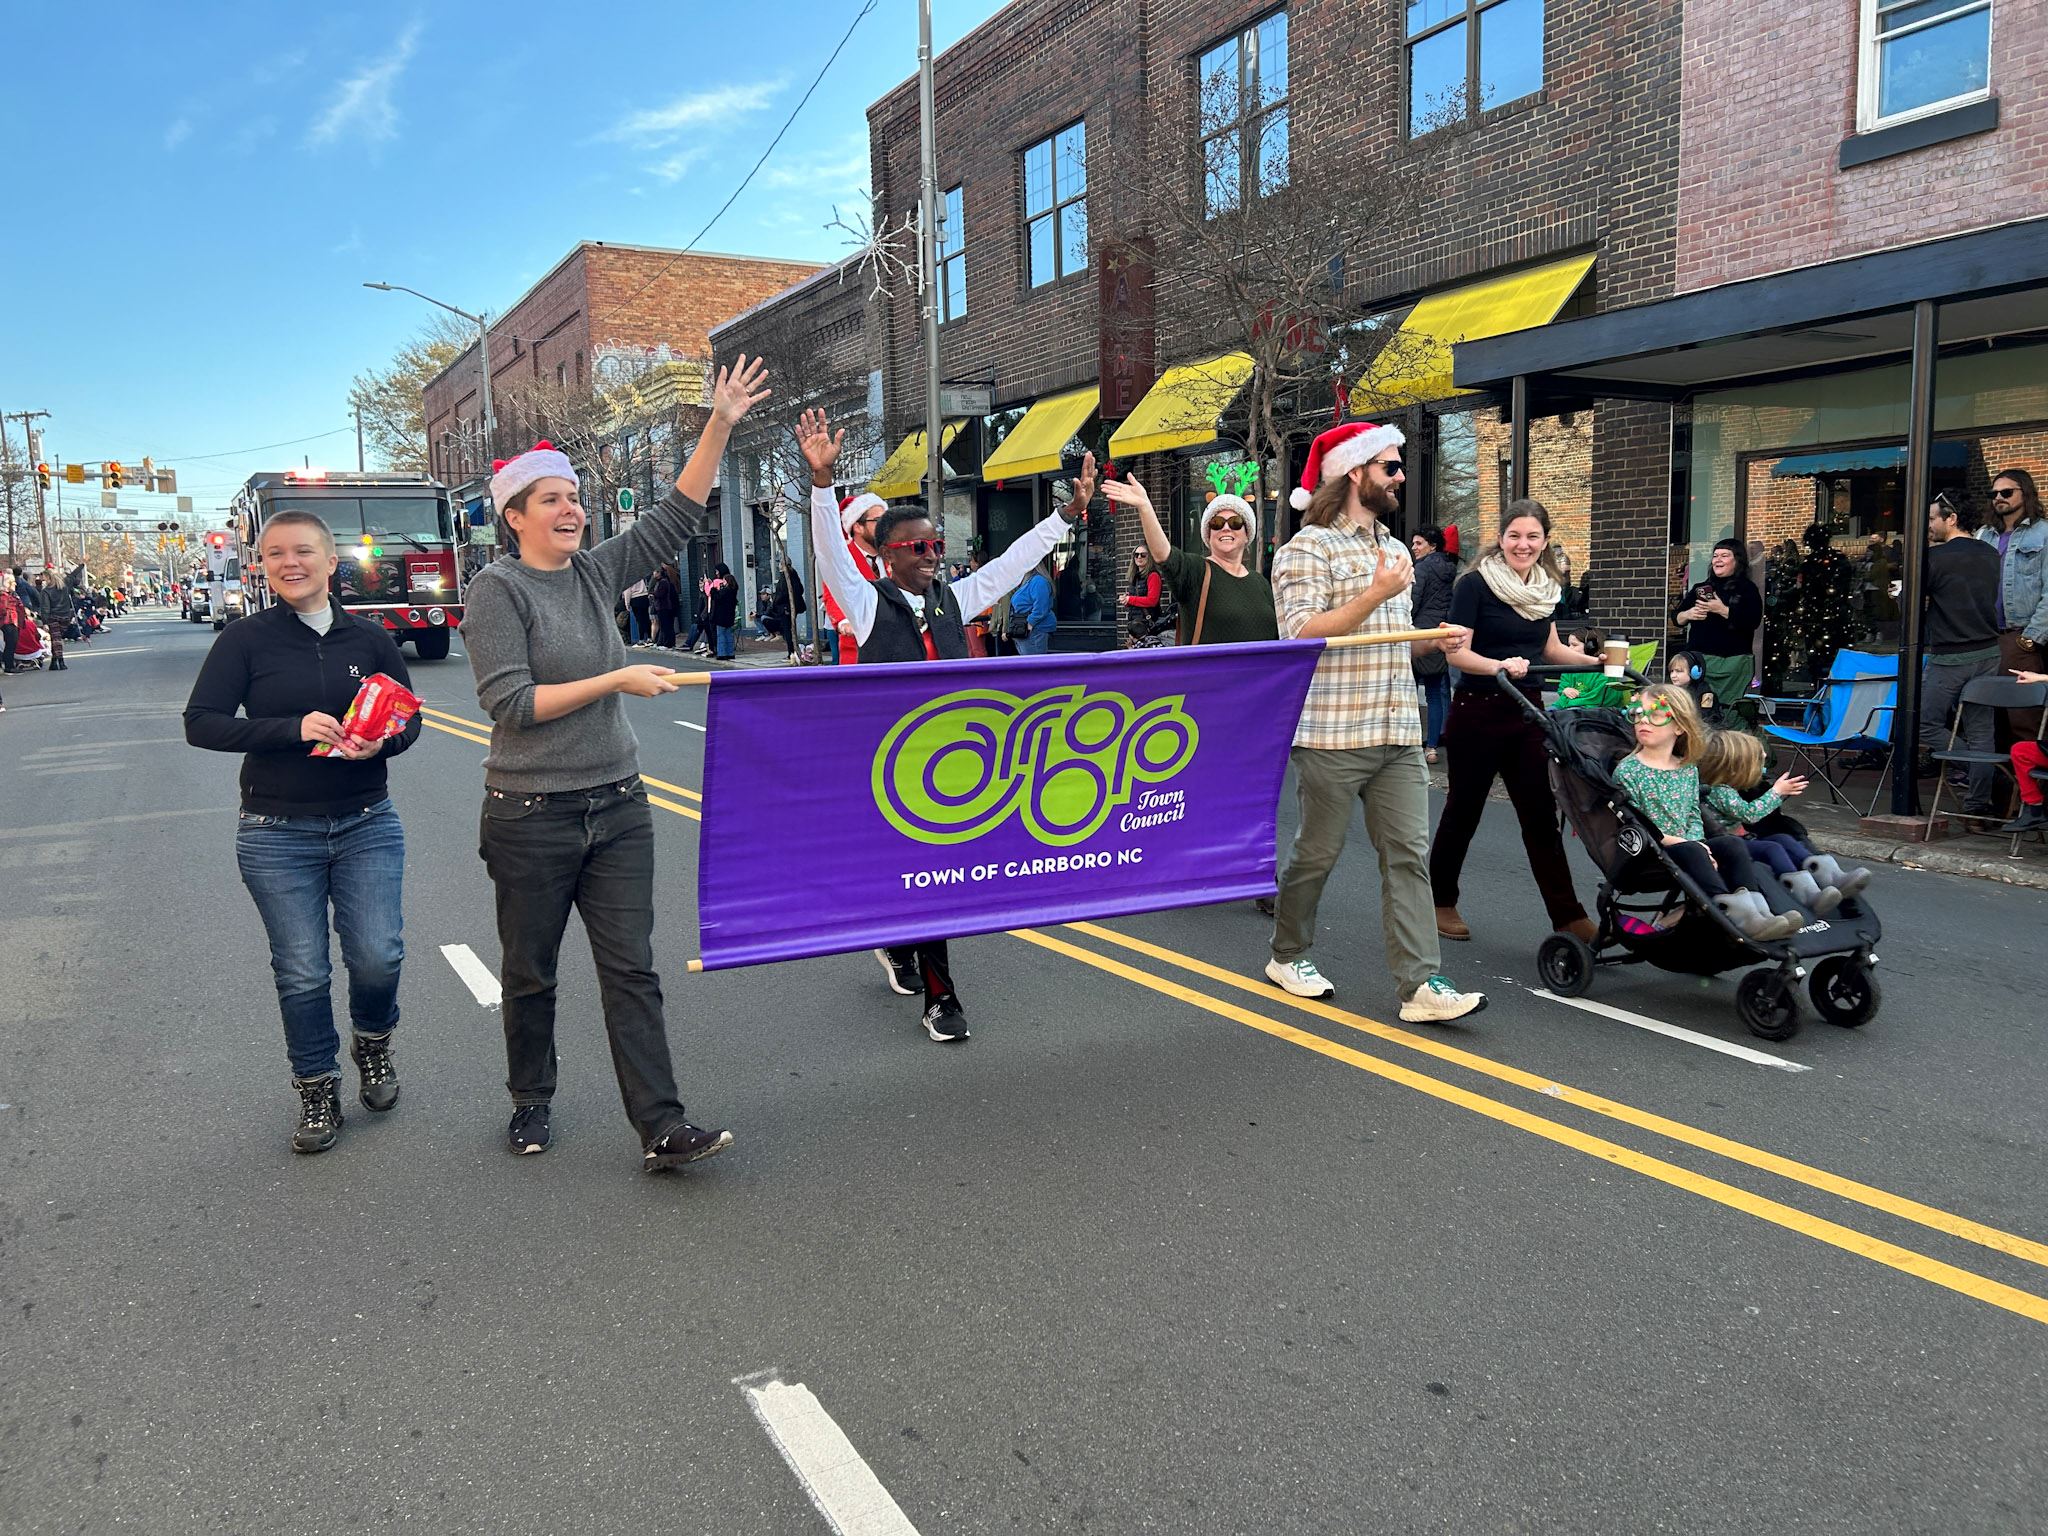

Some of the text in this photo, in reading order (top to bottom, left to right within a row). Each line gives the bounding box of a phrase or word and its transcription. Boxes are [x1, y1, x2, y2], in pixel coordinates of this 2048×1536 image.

[1137, 789, 1185, 811] Town
[1120, 802, 1186, 833] Council
[901, 847, 1143, 890] TOWN OF CARRBORO NC
